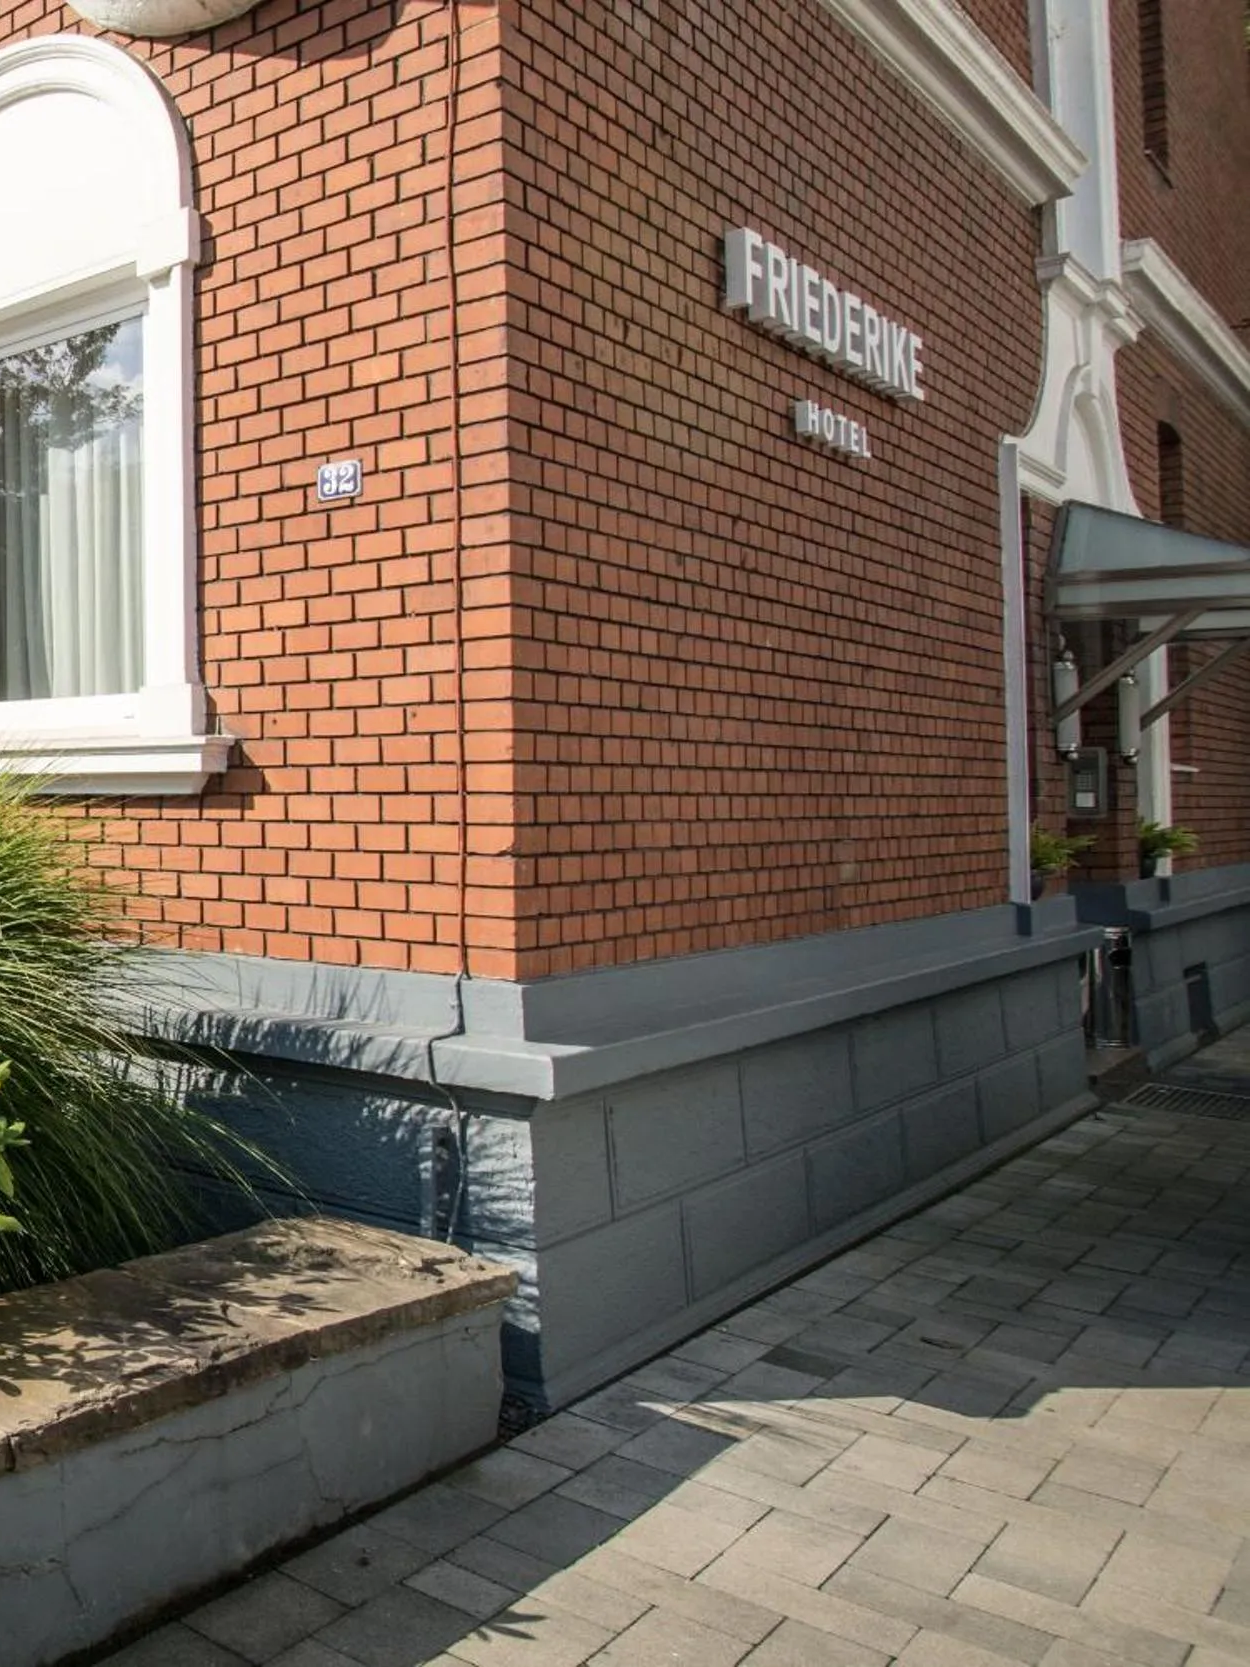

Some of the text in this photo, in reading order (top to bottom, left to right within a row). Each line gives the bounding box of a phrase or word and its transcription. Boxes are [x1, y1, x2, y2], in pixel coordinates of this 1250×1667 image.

[741, 227, 924, 400] FRIEDERIKE
[806, 400, 871, 458] HOTEL
[323, 464, 355, 494] 32
